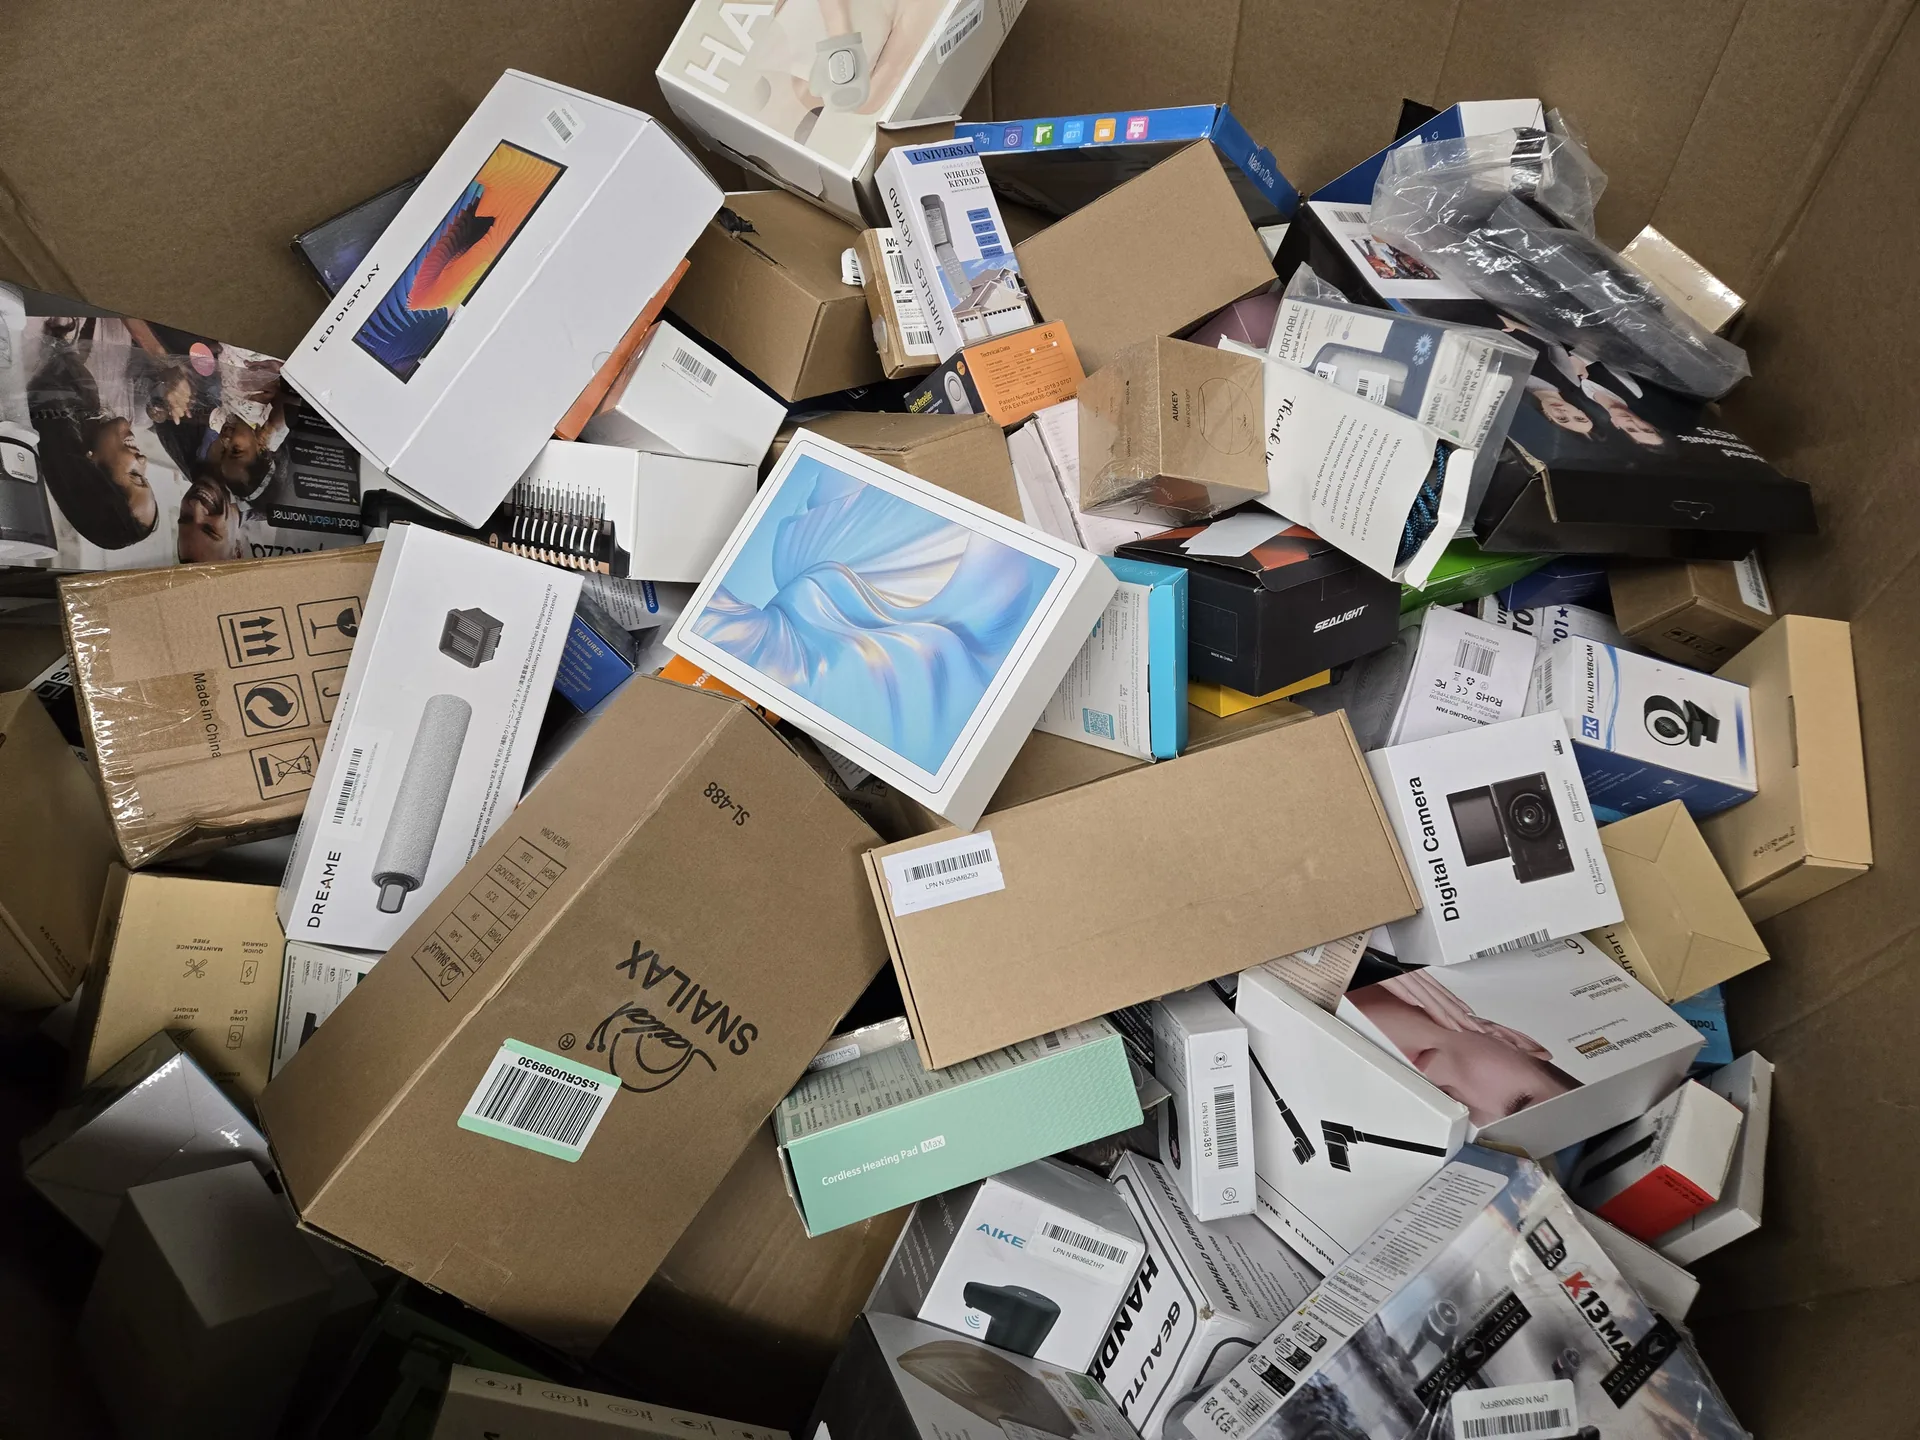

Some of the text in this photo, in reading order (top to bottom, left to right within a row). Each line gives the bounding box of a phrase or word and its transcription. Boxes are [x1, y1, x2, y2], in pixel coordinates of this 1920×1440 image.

[913, 144, 977, 161] UNIVERSAL
[943, 166, 984, 179] WIRELESS
[948, 176, 980, 187] KEYPAD
[1245, 152, 1263, 172] Made
[1260, 169, 1275, 189] China
[889, 187, 944, 335] WIRELESS KEYPAD
[313, 264, 379, 351] LED DISPLAY
[1276, 305, 1299, 358] PORTABLE
[980, 348, 1000, 357] Technical
[1458, 393, 1473, 423] MADE
[1469, 380, 1477, 391] IN
[1473, 346, 1489, 379] CHINA
[908, 388, 935, 413] Pest Repeller
[998, 395, 1016, 406] Patent
[1000, 404, 1012, 412] EPA
[1268, 398, 1293, 444] Thank
[1332, 414, 1346, 438] support
[1346, 419, 1356, 435] need
[1325, 439, 1335, 456] team
[1376, 432, 1389, 456] valued
[1316, 462, 1325, 479] ready
[1352, 449, 1368, 480] products
[1377, 459, 1390, 485] excited
[1320, 483, 1331, 507] friendly
[1331, 483, 1342, 513] questions
[1345, 482, 1356, 504] means
[1368, 495, 1376, 512] have
[272, 509, 359, 530] robot instant warmer
[1350, 506, 1359, 536] purchase
[1313, 605, 1364, 632] SEALIGHT
[574, 628, 603, 657] FEATURES:
[1121, 687, 1127, 696] 24
[1586, 680, 1594, 692] HD
[1472, 702, 1500, 714] INTERFACE
[1475, 691, 1502, 706] RoHS
[193, 672, 221, 757] Made in China
[1435, 705, 1476, 722] COOLING FAN
[1581, 716, 1598, 737] 2K
[486, 789, 500, 816] nettoyage
[703, 781, 749, 825] SL-488
[539, 825, 554, 841] CHINA
[554, 835, 569, 851] MADE
[1409, 777, 1459, 921] Digital Camera
[1584, 847, 1592, 863] screen
[541, 865, 558, 881] WEIGHT
[307, 851, 340, 927] DREAME
[924, 881, 938, 889] LPN
[506, 906, 521, 921] INPUT
[485, 926, 504, 944] POWER
[1564, 938, 1584, 954] 6
[467, 948, 485, 965] MODEL
[1599, 974, 1622, 986] Beauty
[617, 941, 756, 1054] SNAILAX
[172, 1005, 199, 1013] WEIGHT
[1648, 1019, 1676, 1036] Vacuum
[1616, 1028, 1651, 1050] Blackhead
[518, 1056, 598, 1090] tsSCRU098930
[922, 1138, 942, 1150] Max
[820, 1145, 918, 1185] Cordless Heating Pad
[1147, 1159, 1177, 1204] STEAMER
[976, 1223, 1025, 1248] AIKE
[1172, 1202, 1205, 1251] GARMENT
[1254, 1194, 1334, 1265] SYNC & Charging
[1051, 1246, 1065, 1255] LPN
[1199, 1249, 1239, 1311] HANDHELD
[1488, 1312, 1522, 1346] CANADA
[1620, 1364, 1650, 1395] POSTES
[1525, 1393, 1548, 1404] LPN N
